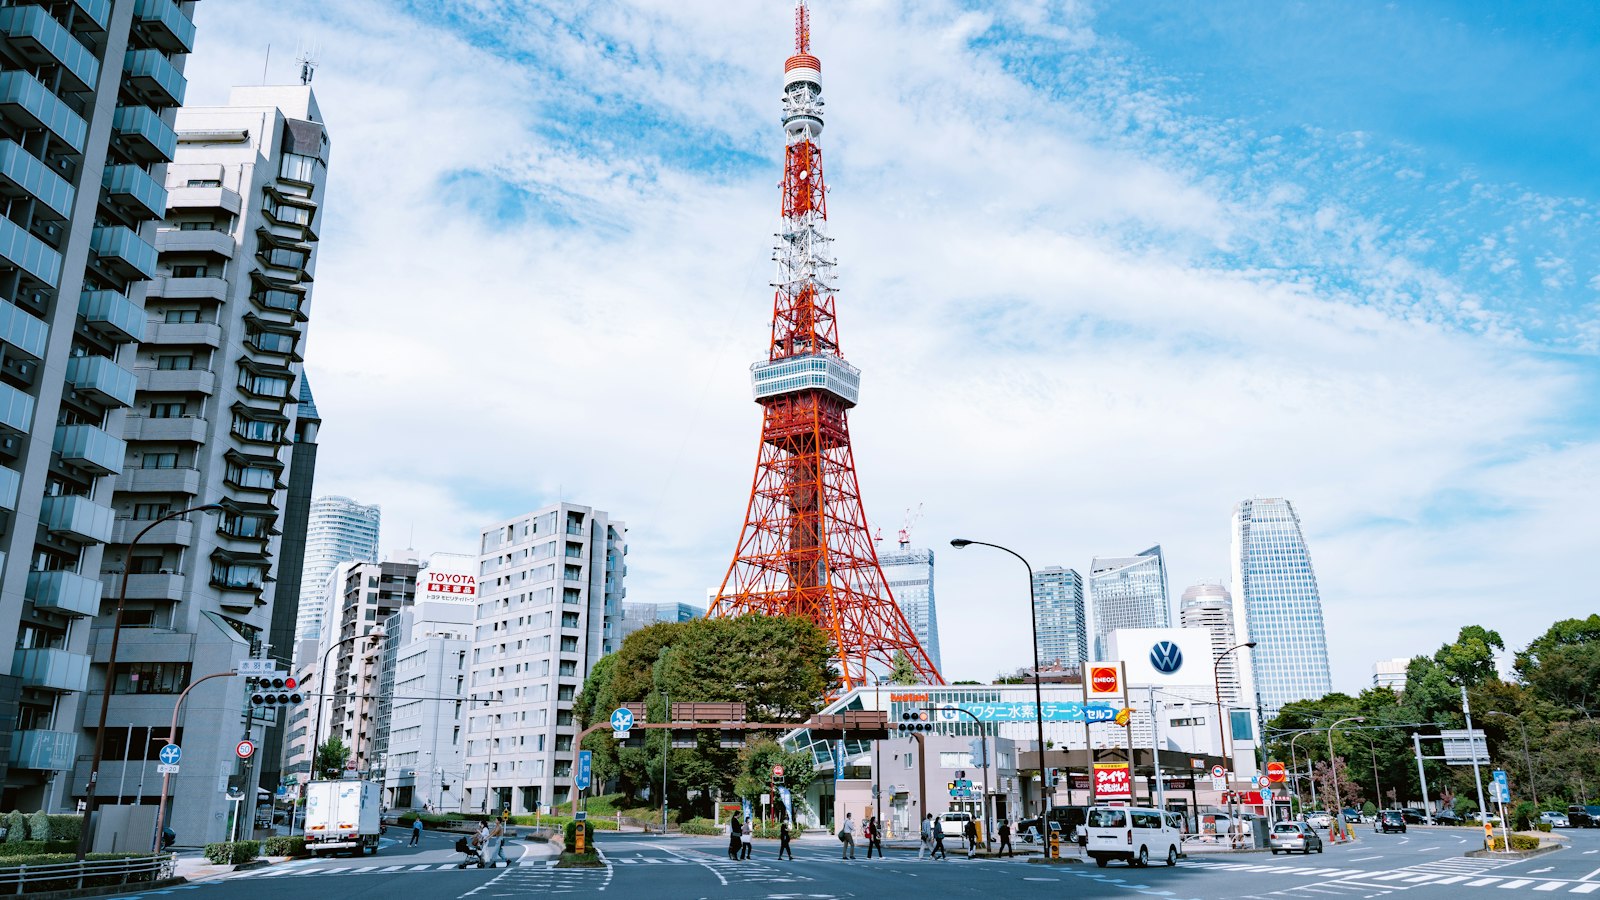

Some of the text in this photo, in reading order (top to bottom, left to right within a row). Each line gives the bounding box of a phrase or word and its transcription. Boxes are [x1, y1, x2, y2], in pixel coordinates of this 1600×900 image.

[429, 572, 475, 584] TOYOTA
[431, 583, 472, 594] 純正部品
[890, 693, 929, 702] Iwatani
[1086, 709, 1113, 719] セルフ
[240, 745, 250, 753] 50
[1096, 770, 1127, 782] タイヤ
